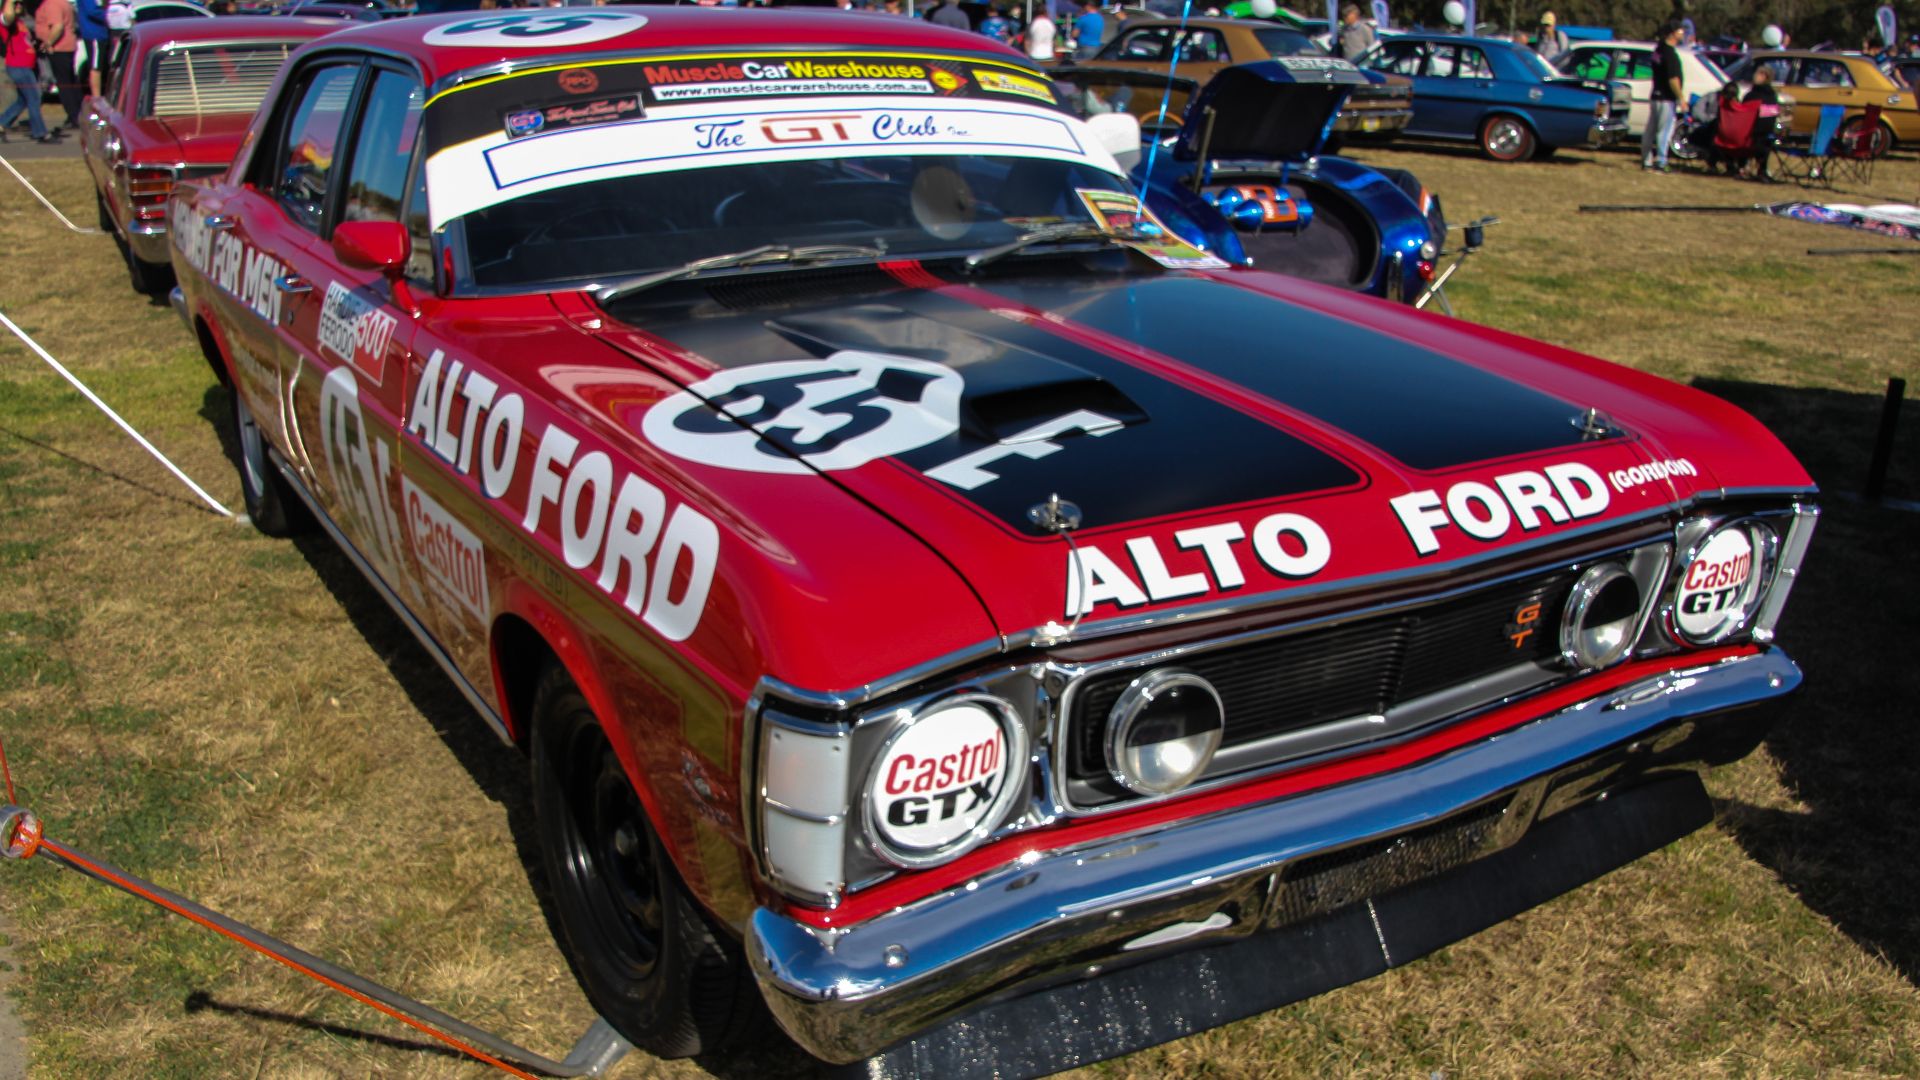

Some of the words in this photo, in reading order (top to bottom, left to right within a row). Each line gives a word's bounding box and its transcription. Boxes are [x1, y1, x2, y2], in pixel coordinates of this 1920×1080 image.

[643, 60, 926, 85] MuscleCarWarehouse
[660, 82, 928, 98] www.musclecarwarehouse.com.au
[694, 119, 746, 149] The
[761, 115, 863, 145] GT
[872, 114, 940, 141] Club
[211, 230, 244, 297] FOR
[241, 245, 288, 326] MEN
[319, 311, 357, 360] FERODO
[355, 308, 390, 360] 500
[407, 348, 525, 499] ALTO
[522, 423, 720, 642] FORD
[408, 490, 485, 614] Castrol
[1063, 511, 1332, 619] ALTO
[1389, 461, 1611, 557] FORD
[885, 725, 1002, 795] Castrol
[887, 771, 998, 827] GTX
